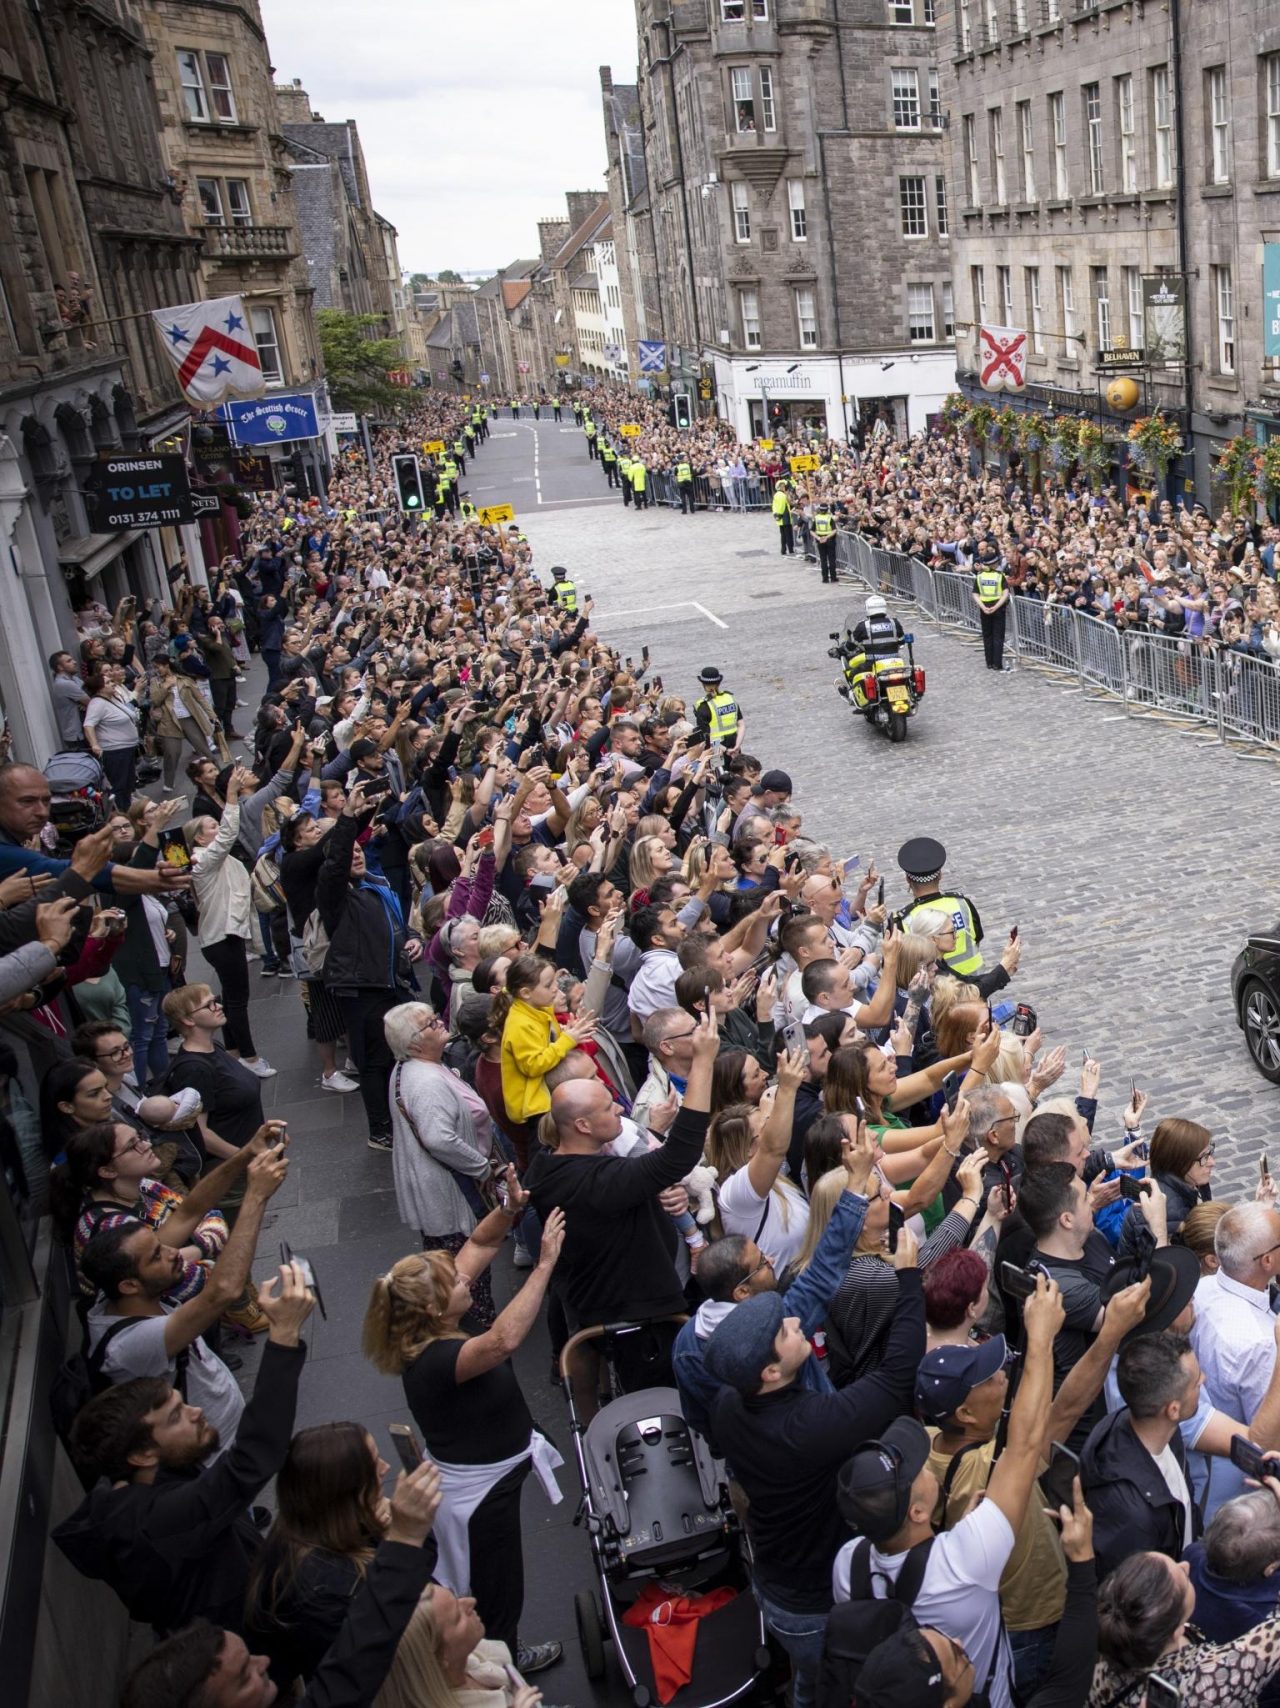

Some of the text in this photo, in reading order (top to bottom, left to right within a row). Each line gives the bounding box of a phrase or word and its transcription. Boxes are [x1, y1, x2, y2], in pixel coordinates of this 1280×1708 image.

[1103, 351, 1139, 362] BELHAVEN
[753, 372, 812, 391] ragamuffin
[240, 403, 308, 424] The Scottish Grocer
[107, 460, 162, 473] ORINSEN
[107, 483, 171, 501] TO LET
[109, 509, 181, 525] 0131 374 1111
[718, 703, 737, 715] POLICE
